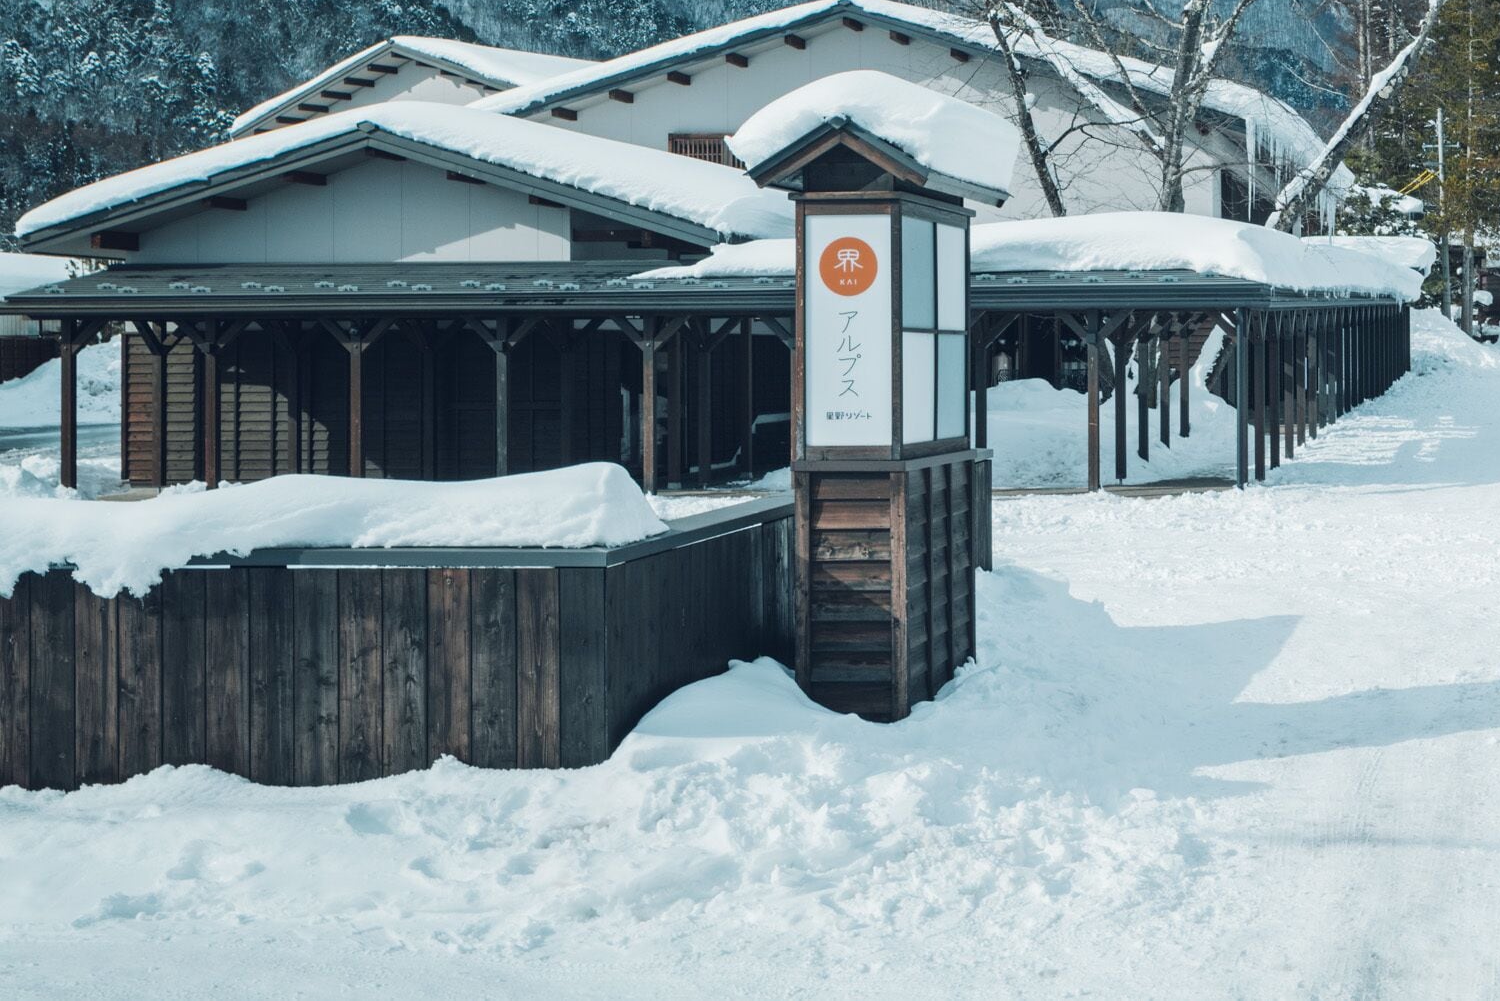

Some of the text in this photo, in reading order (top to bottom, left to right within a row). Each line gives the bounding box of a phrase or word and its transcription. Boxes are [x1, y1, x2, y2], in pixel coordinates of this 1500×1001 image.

[834, 249, 863, 272] 界
[836, 310, 862, 397] アルプス
[826, 409, 873, 420] 星野リゾート
